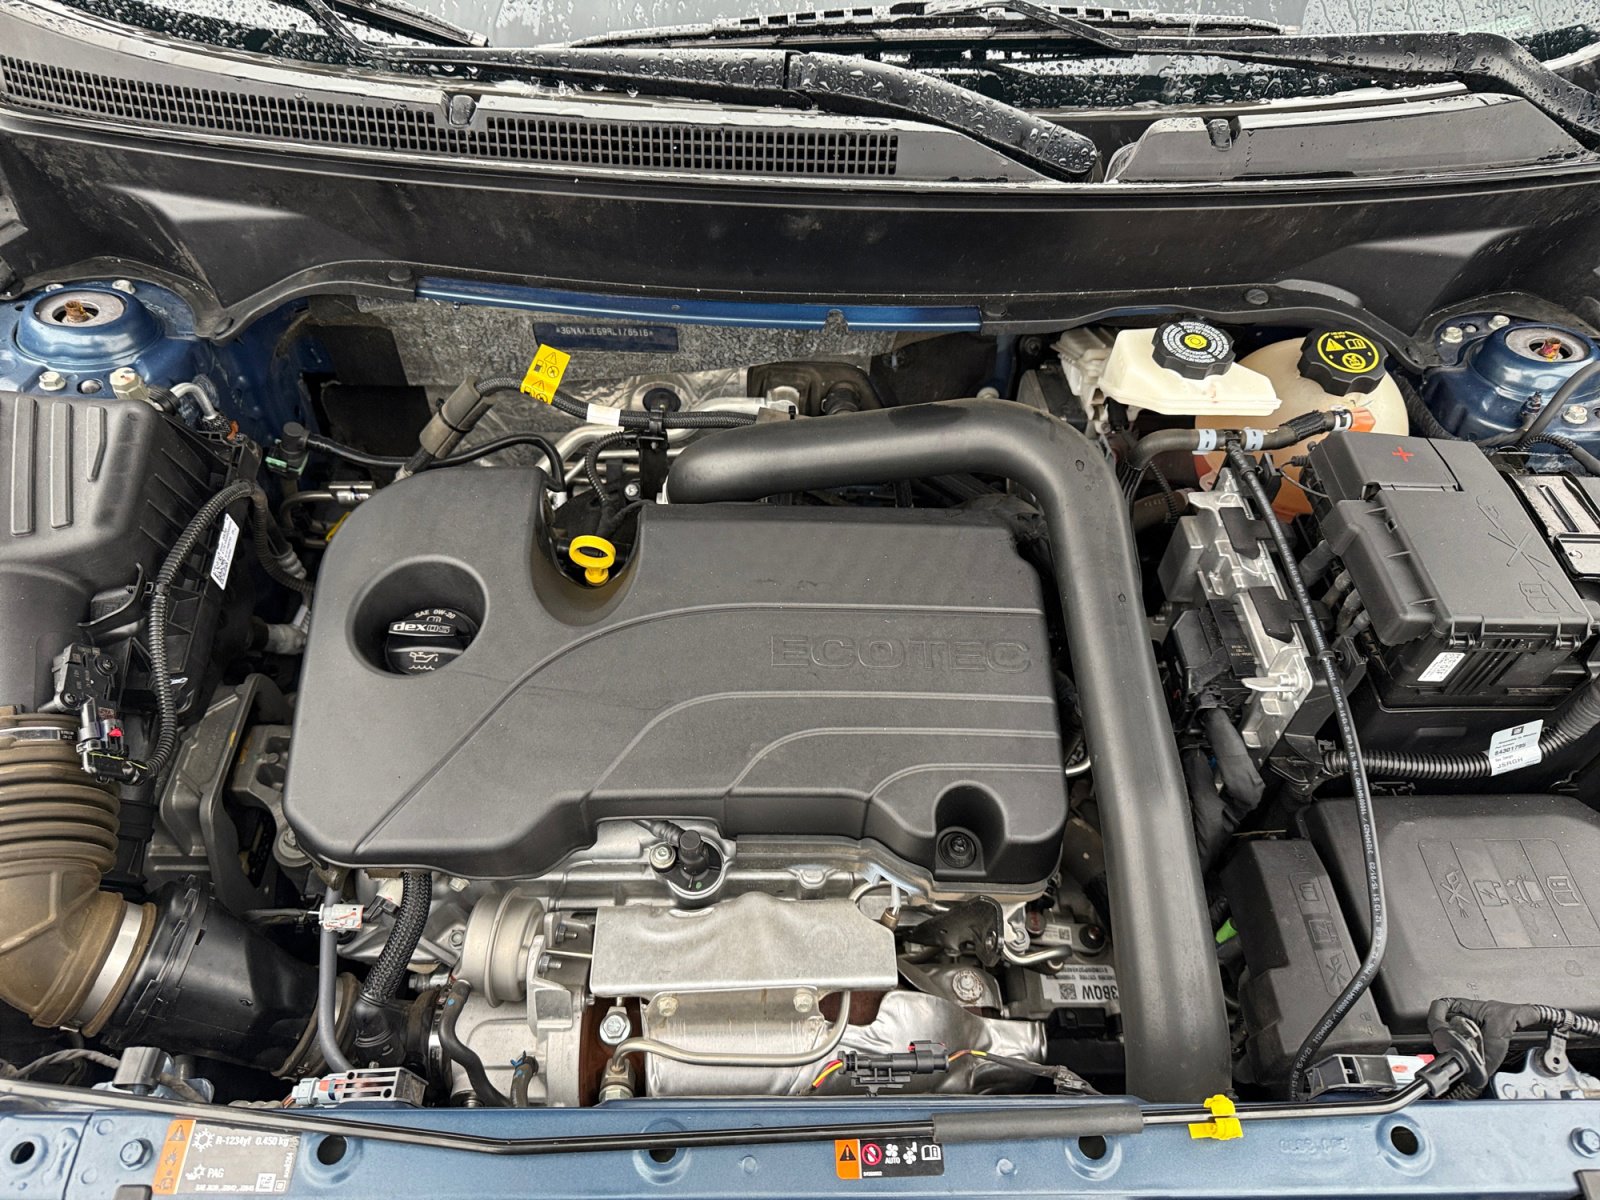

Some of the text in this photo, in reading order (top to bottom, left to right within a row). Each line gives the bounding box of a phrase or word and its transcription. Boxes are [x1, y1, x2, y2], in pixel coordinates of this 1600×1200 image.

[414, 609, 456, 619] SAE 0W-20
[393, 622, 451, 634] dexos
[771, 635, 1032, 673] ECOTEC
[1368, 861, 1378, 889] 15/01/23
[1082, 984, 1119, 1001] 3BQW
[255, 1135, 277, 1146] 0.450
[278, 1137, 289, 1147] kg
[206, 1167, 225, 1178] PAG
